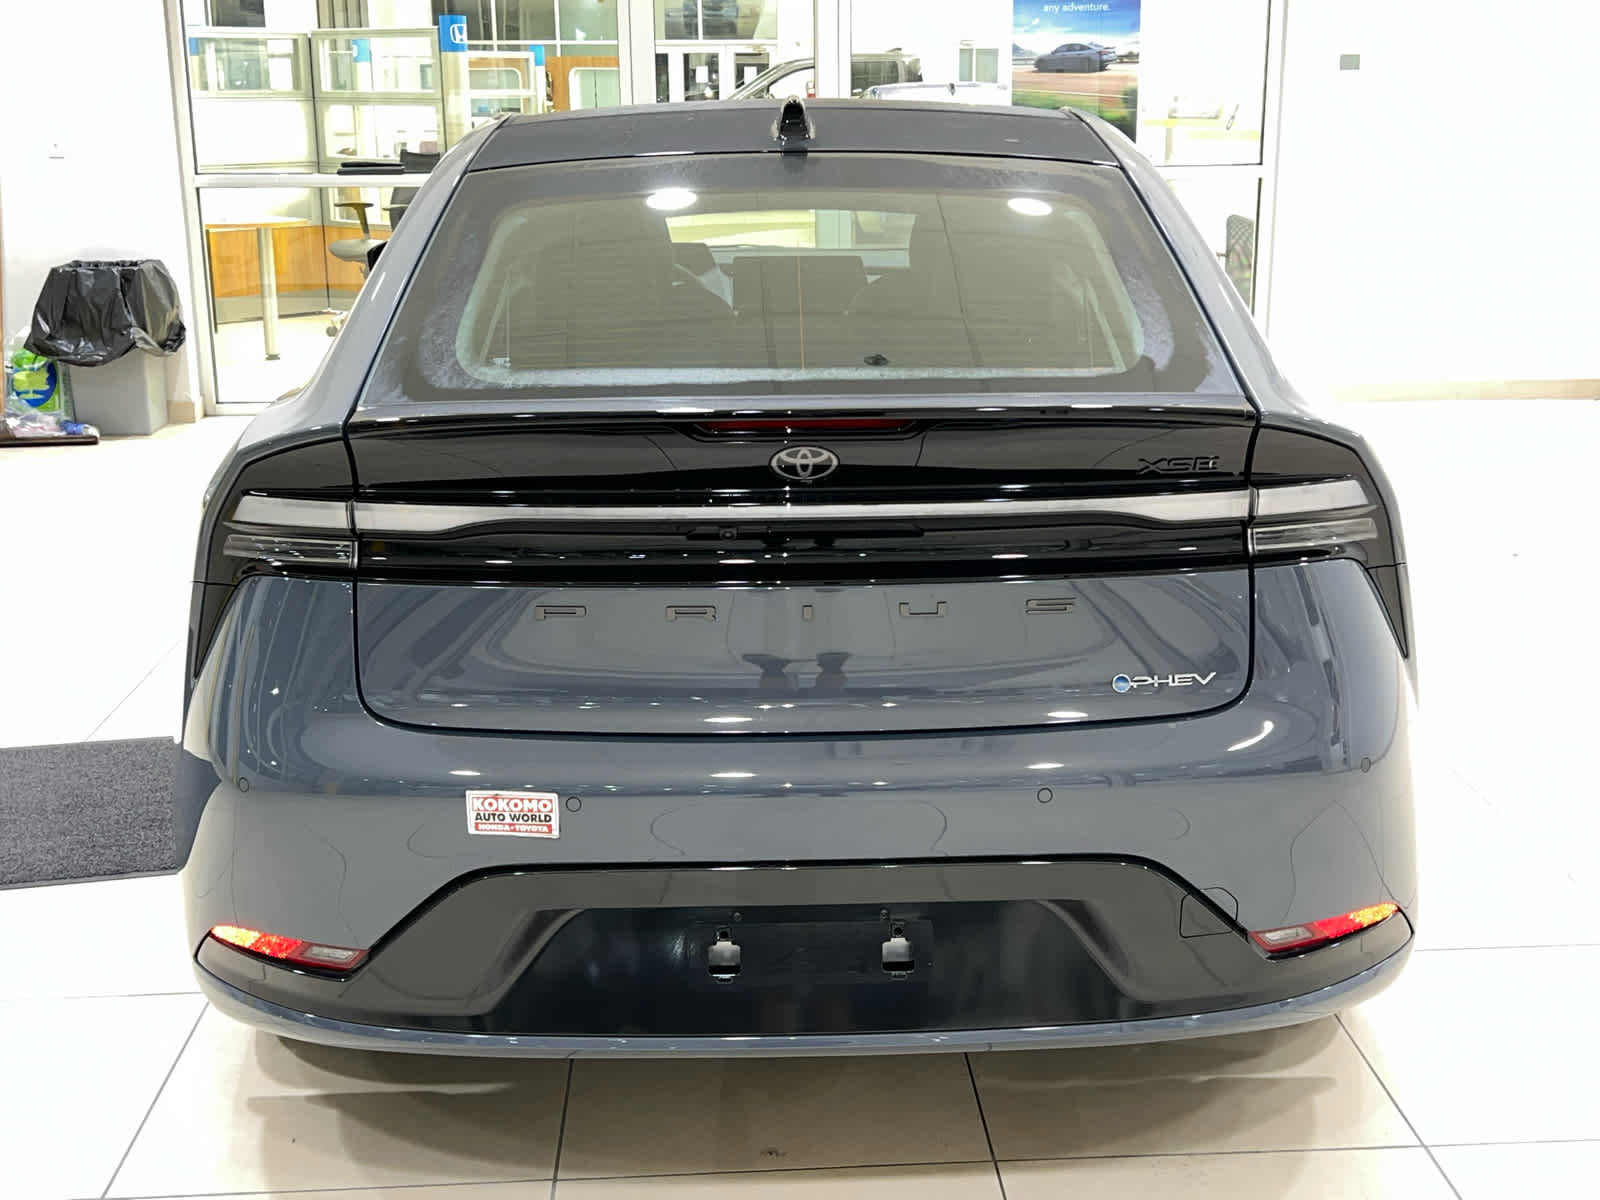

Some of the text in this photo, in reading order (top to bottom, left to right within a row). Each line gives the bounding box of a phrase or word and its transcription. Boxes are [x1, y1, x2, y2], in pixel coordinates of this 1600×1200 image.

[1043, 2, 1110, 14] any adventure.
[1136, 455, 1220, 475] XSE
[534, 597, 1077, 621] PRIUS
[472, 798, 553, 812] KOKOMO
[475, 812, 552, 823] AUTO WORLD
